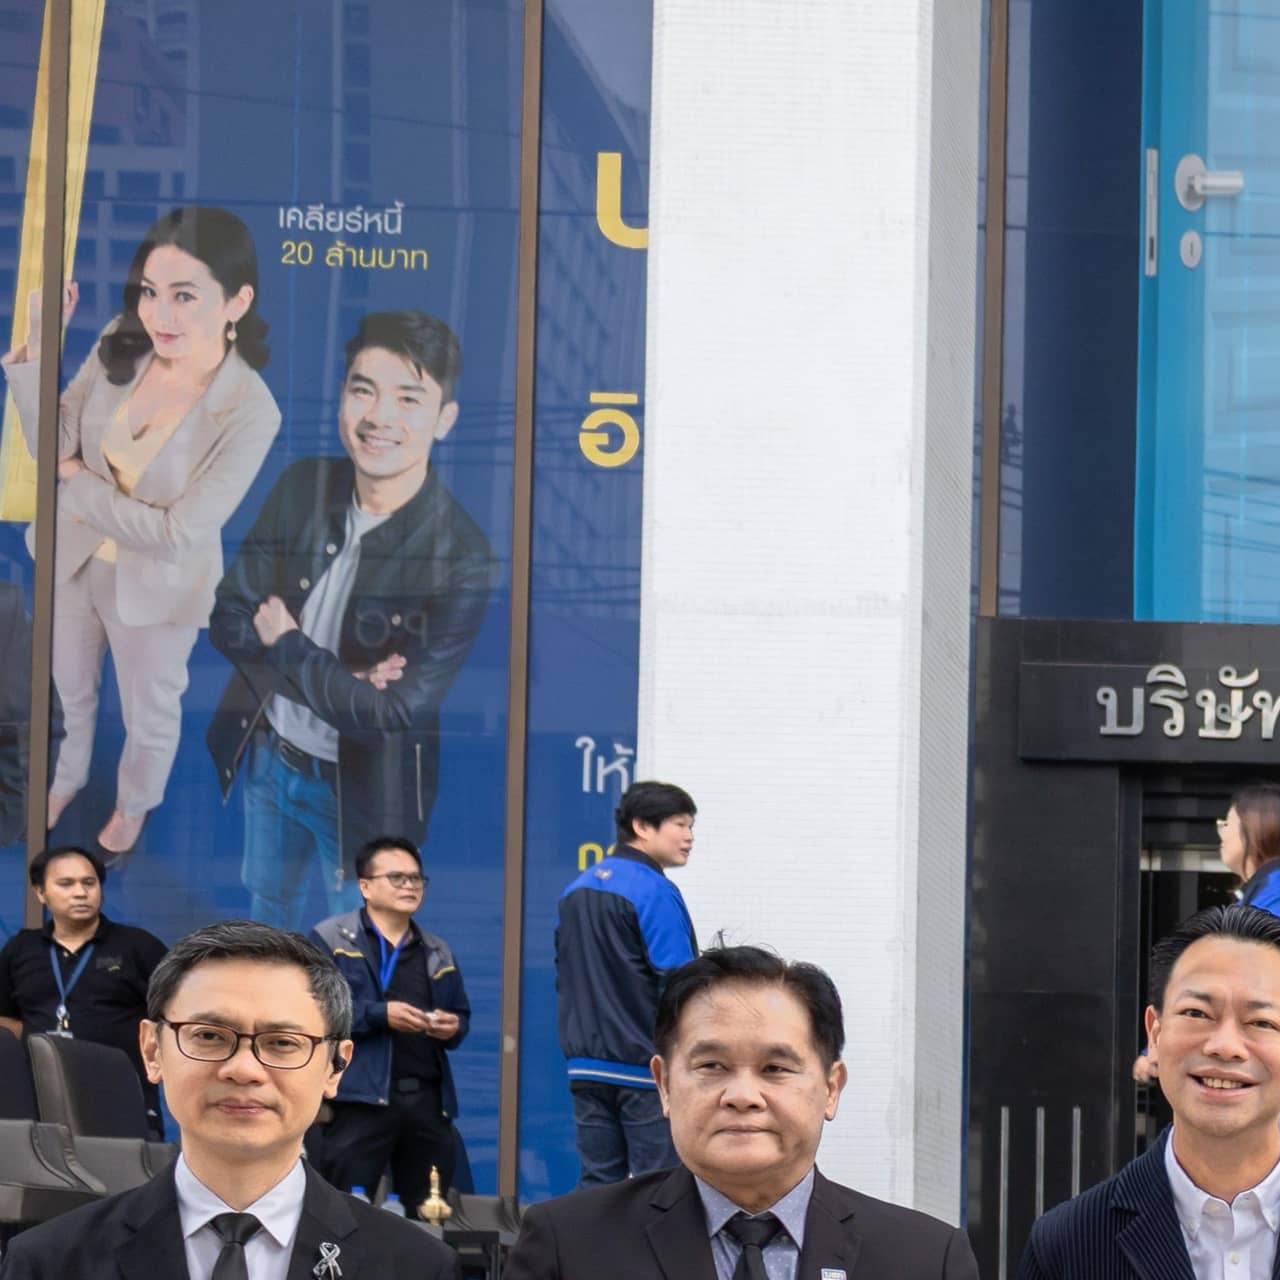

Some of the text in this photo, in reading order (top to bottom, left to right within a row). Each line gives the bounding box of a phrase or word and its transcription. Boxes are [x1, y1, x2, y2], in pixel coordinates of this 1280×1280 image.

[278, 200, 405, 235] เคลียร์หนี้
[281, 240, 429, 271] 20 ล้านบาท
